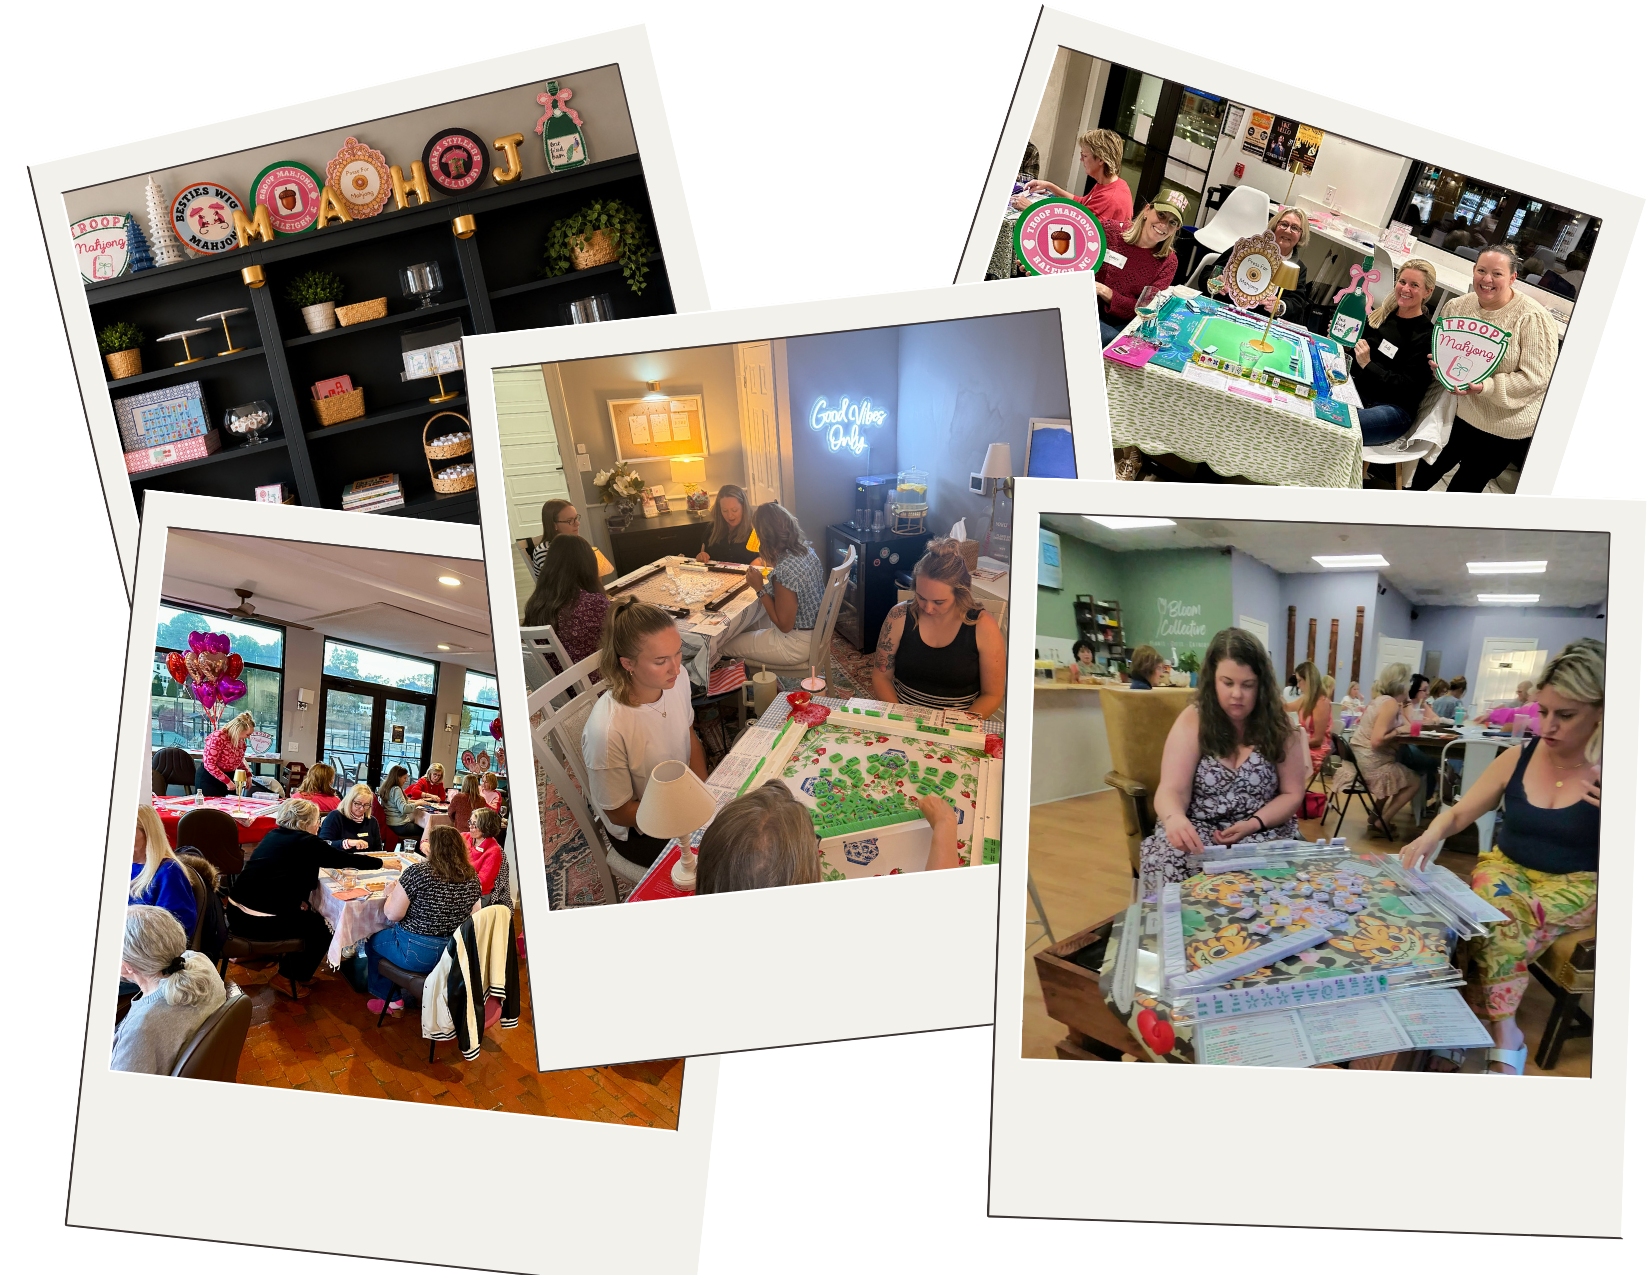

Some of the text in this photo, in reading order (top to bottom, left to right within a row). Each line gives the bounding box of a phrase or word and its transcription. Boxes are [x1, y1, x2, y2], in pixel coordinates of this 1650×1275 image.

[176, 187, 239, 222] BESTIES WIG
[1026, 207, 1095, 237] TROOP MAHJONG
[189, 227, 238, 250] MAHJON
[1032, 255, 1075, 275] RALEIGH
[1078, 256, 1091, 270] NC
[1445, 319, 1500, 339] TROOP
[1440, 333, 1496, 363] Mahjong
[812, 398, 888, 429] Good Vibes
[829, 424, 868, 455] Only
[1167, 600, 1201, 617] Bloom
[1161, 619, 1206, 637] Collective
